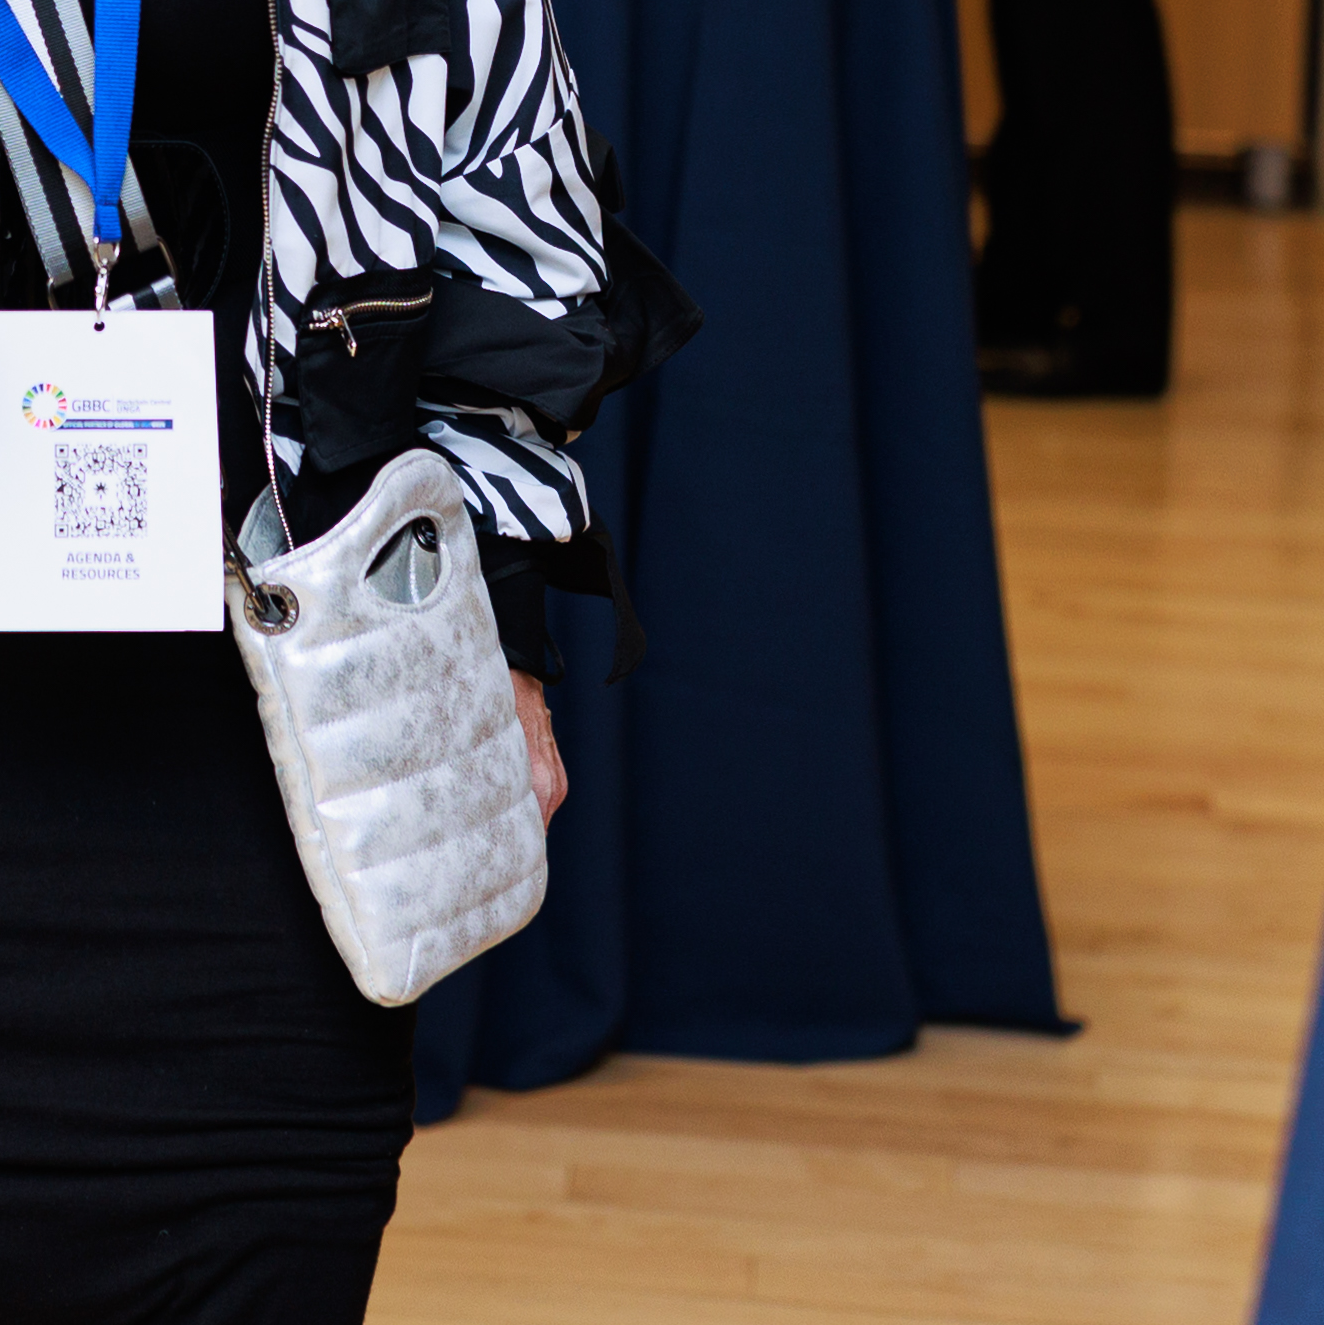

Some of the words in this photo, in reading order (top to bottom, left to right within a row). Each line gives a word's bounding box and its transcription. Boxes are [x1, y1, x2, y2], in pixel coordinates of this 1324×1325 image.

[71, 399, 111, 413] GBBC
[116, 405, 141, 414] UNGA
[66, 552, 122, 564] AGENDA
[125, 552, 135, 564] &
[61, 568, 141, 580] RESOURCES
